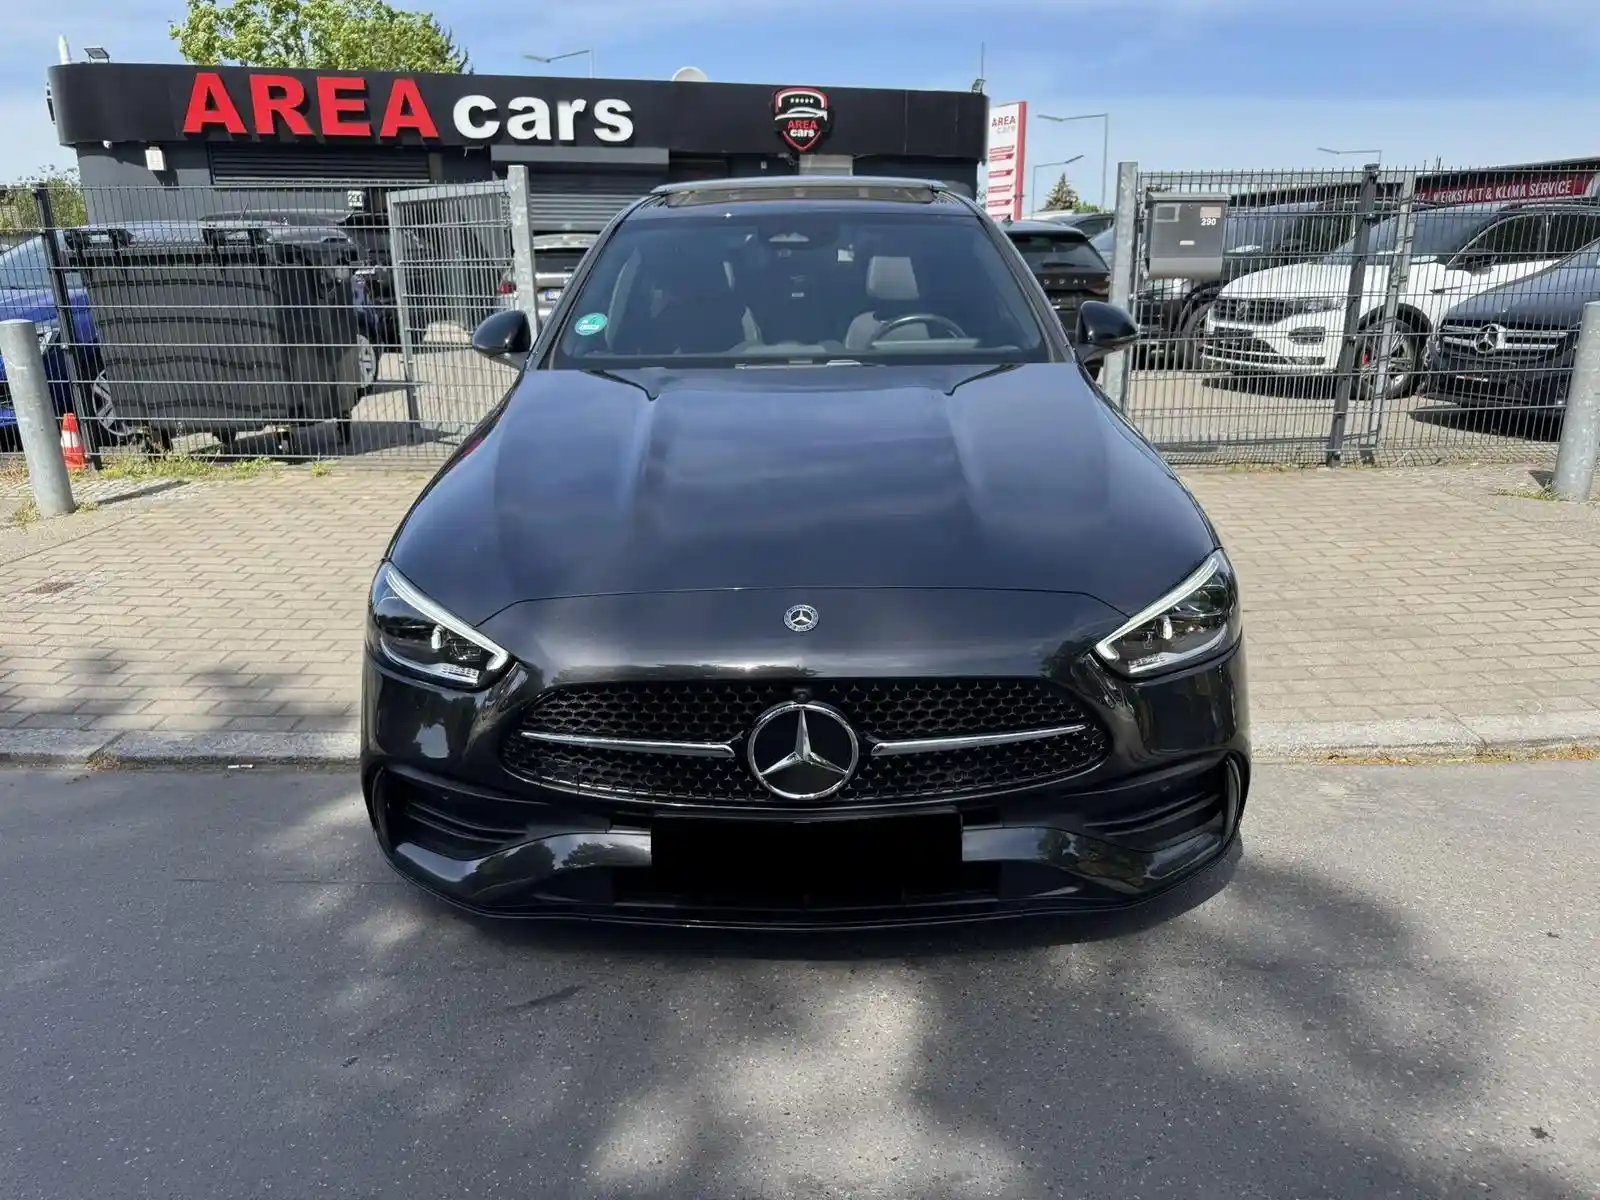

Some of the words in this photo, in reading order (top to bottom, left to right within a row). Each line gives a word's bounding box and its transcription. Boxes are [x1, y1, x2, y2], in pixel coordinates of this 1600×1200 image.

[183, 72, 439, 139] AREA
[452, 94, 634, 142] cars
[788, 120, 817, 129] AREA
[991, 115, 1017, 128] AREA
[790, 129, 815, 138] cars
[1485, 187, 1493, 200] &
[1495, 183, 1526, 200] KLIMA
[1529, 179, 1573, 197] SERVICE
[1201, 218, 1217, 226] 290
